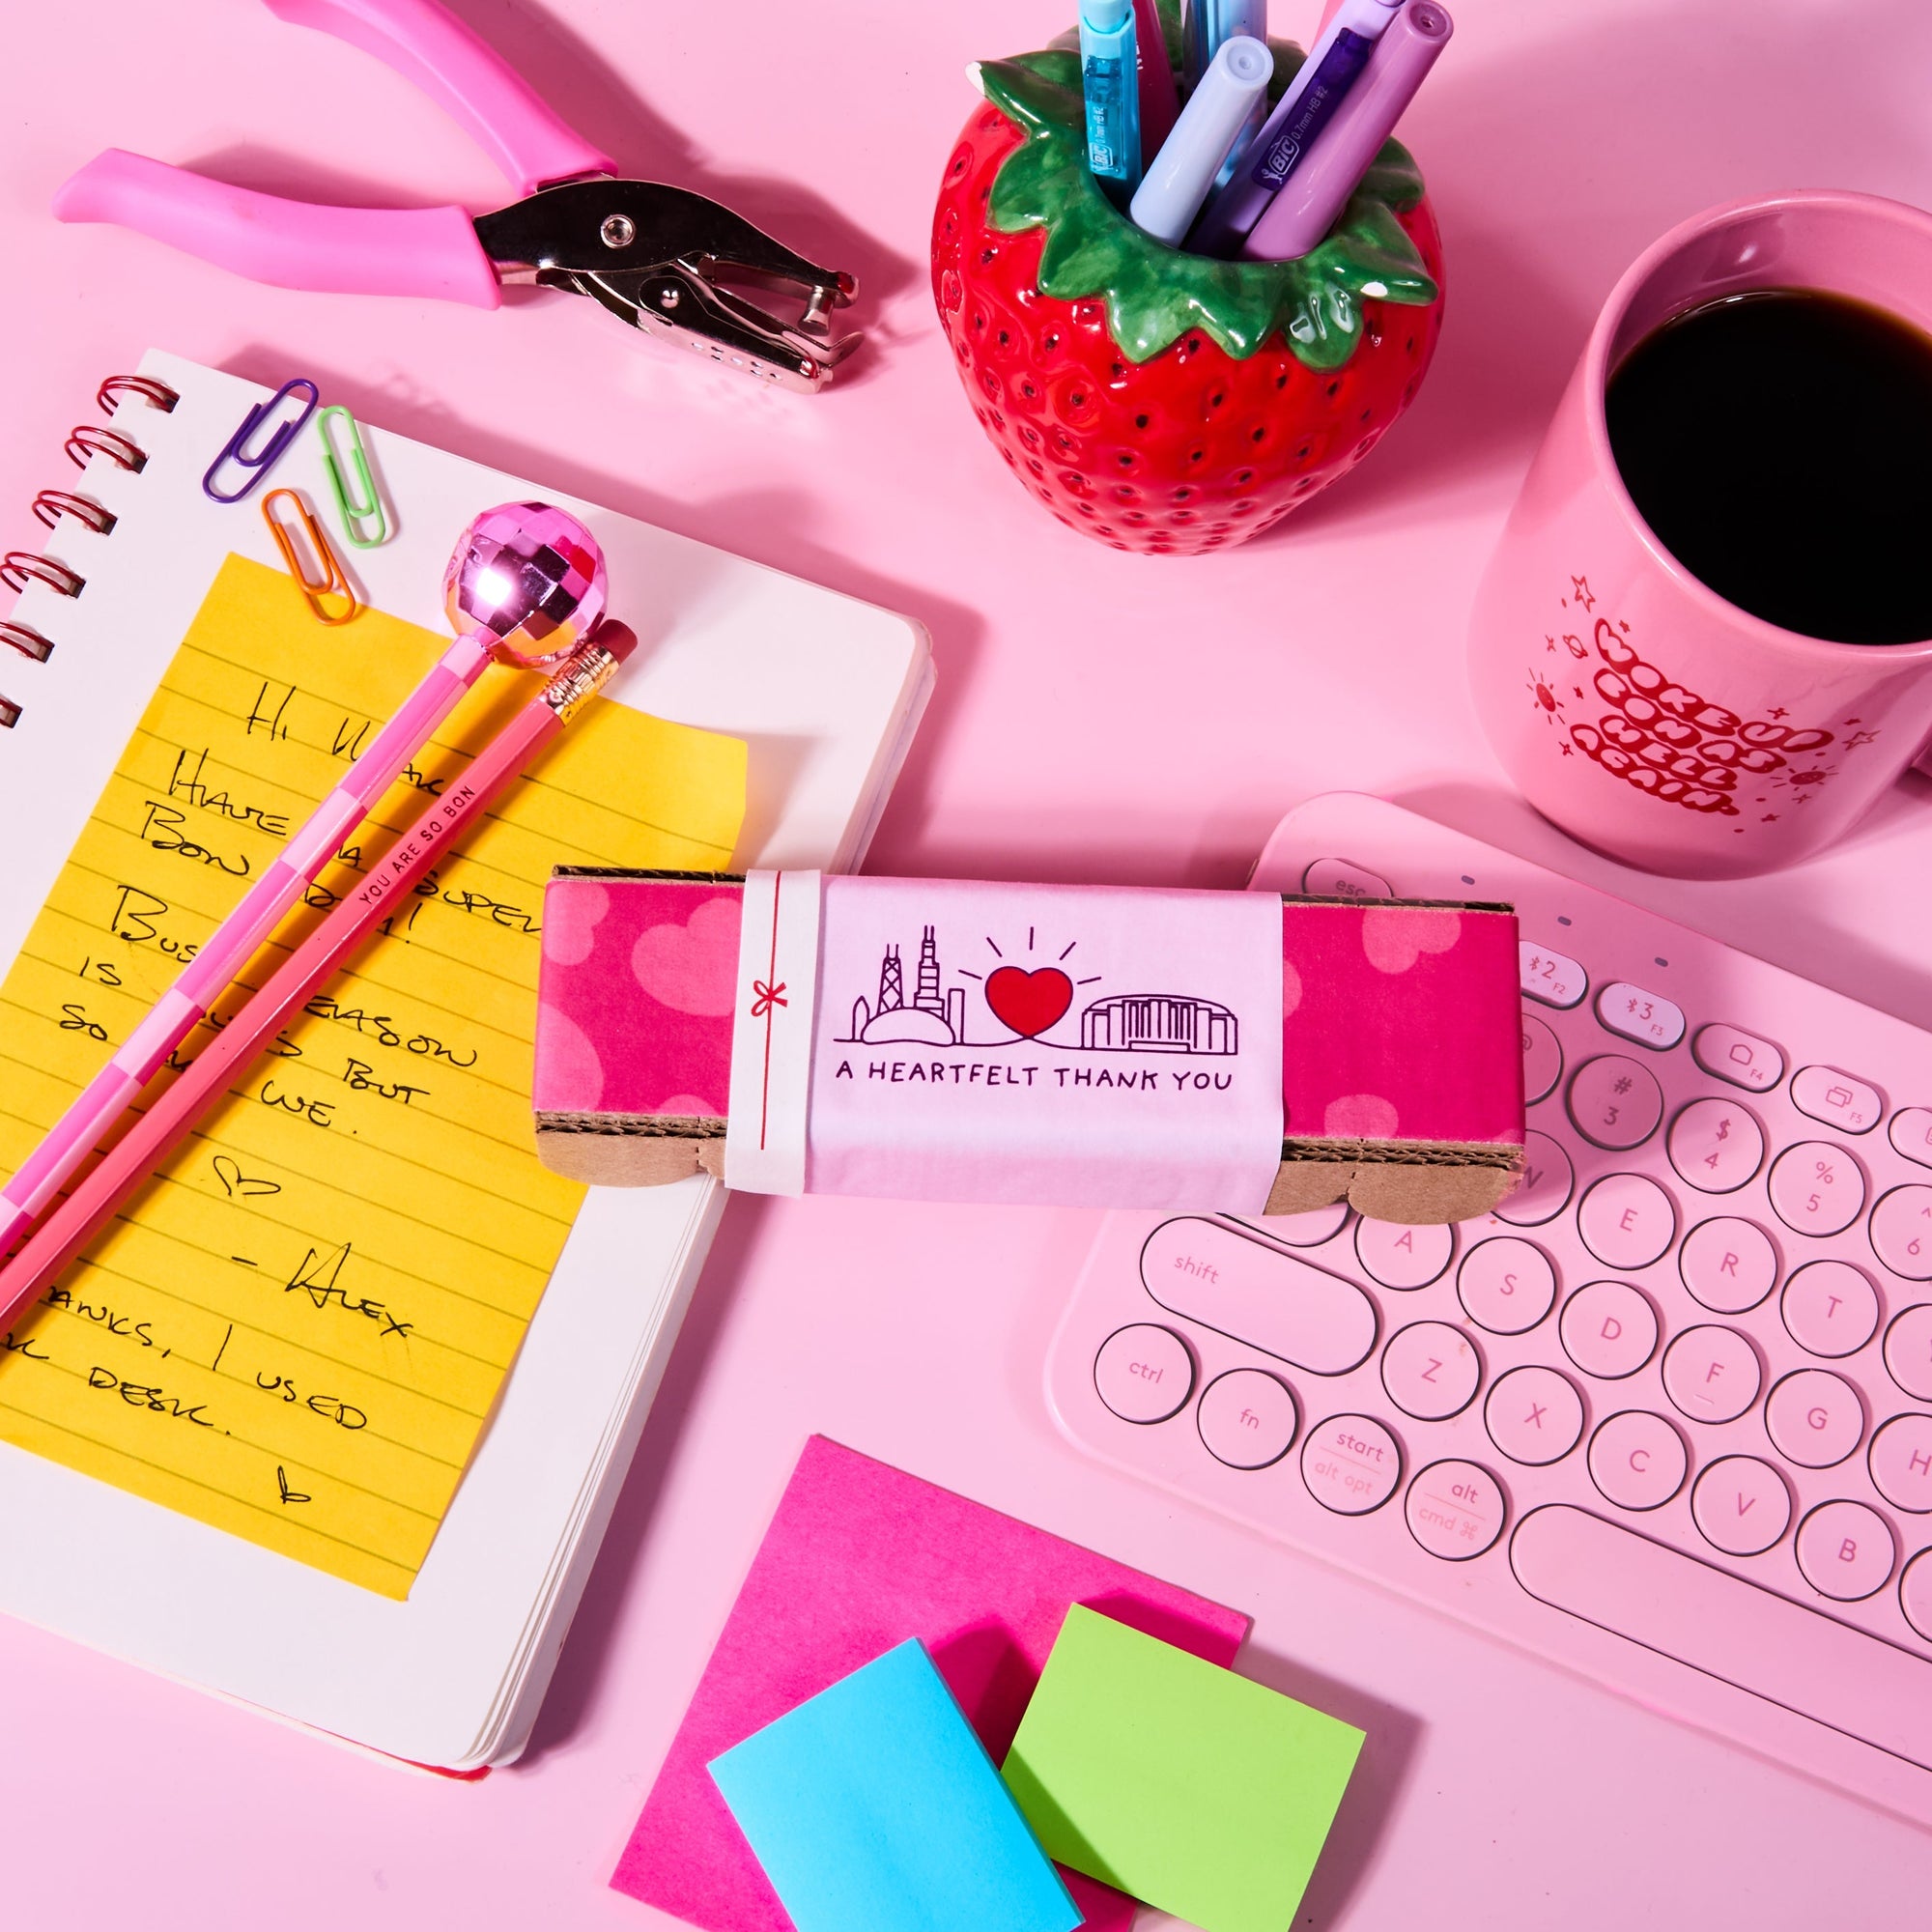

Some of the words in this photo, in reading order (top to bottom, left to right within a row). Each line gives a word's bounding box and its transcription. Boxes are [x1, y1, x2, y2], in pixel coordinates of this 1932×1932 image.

[1272, 138, 1295, 172] BIC
[1291, 113, 1314, 140] 0.7mm
[1307, 97, 1321, 113] HB
[1315, 85, 1328, 99] #2
[1094, 145, 1109, 165] BIC
[1594, 618, 1742, 736] WOKE
[1599, 714, 1737, 791] HELL
[359, 874, 391, 904] YOU
[392, 842, 421, 874] ARE
[420, 821, 442, 841] SO
[442, 785, 475, 818] BON
[1335, 879, 1367, 896] esc
[1542, 960, 1556, 980] 2
[1552, 982, 1566, 995] F2
[1639, 1002, 1655, 1020] 3
[1650, 1024, 1664, 1037] F3
[836, 1061, 853, 1079] A
[868, 1063, 1038, 1087] HEARTFELT
[1055, 1067, 1158, 1091] THANK
[1172, 1072, 1233, 1092] YOU
[1613, 1076, 1633, 1095] #
[1750, 1068, 1763, 1081] F4
[1604, 1106, 1620, 1125] 3
[1850, 1112, 1862, 1124] F5
[1716, 1119, 1731, 1142] $
[1704, 1152, 1719, 1170] 4
[1816, 1161, 1833, 1184] %
[1806, 1193, 1821, 1212] 5
[1619, 1208, 1638, 1233] E
[1394, 1230, 1412, 1254] A
[1907, 1237, 1920, 1256] 6
[1174, 1256, 1219, 1285] shift
[1720, 1251, 1740, 1278] R
[1499, 1274, 1518, 1296] S
[1827, 1294, 1843, 1319] T
[1600, 1317, 1622, 1341] D
[1128, 1361, 1164, 1384] ctrl
[1421, 1358, 1443, 1383] Z
[1706, 1362, 1725, 1383] F
[1239, 1408, 1260, 1430] fn
[1523, 1403, 1548, 1429] X
[1807, 1406, 1829, 1431] G
[1336, 1433, 1384, 1463] start
[1629, 1449, 1650, 1474] C
[1909, 1449, 1932, 1476] H
[1315, 1461, 1339, 1481] alt
[1344, 1474, 1374, 1495] opt
[1451, 1484, 1479, 1504] alt
[1733, 1492, 1756, 1517] V
[1419, 1507, 1457, 1531] cmd
[1838, 1538, 1857, 1563] B
